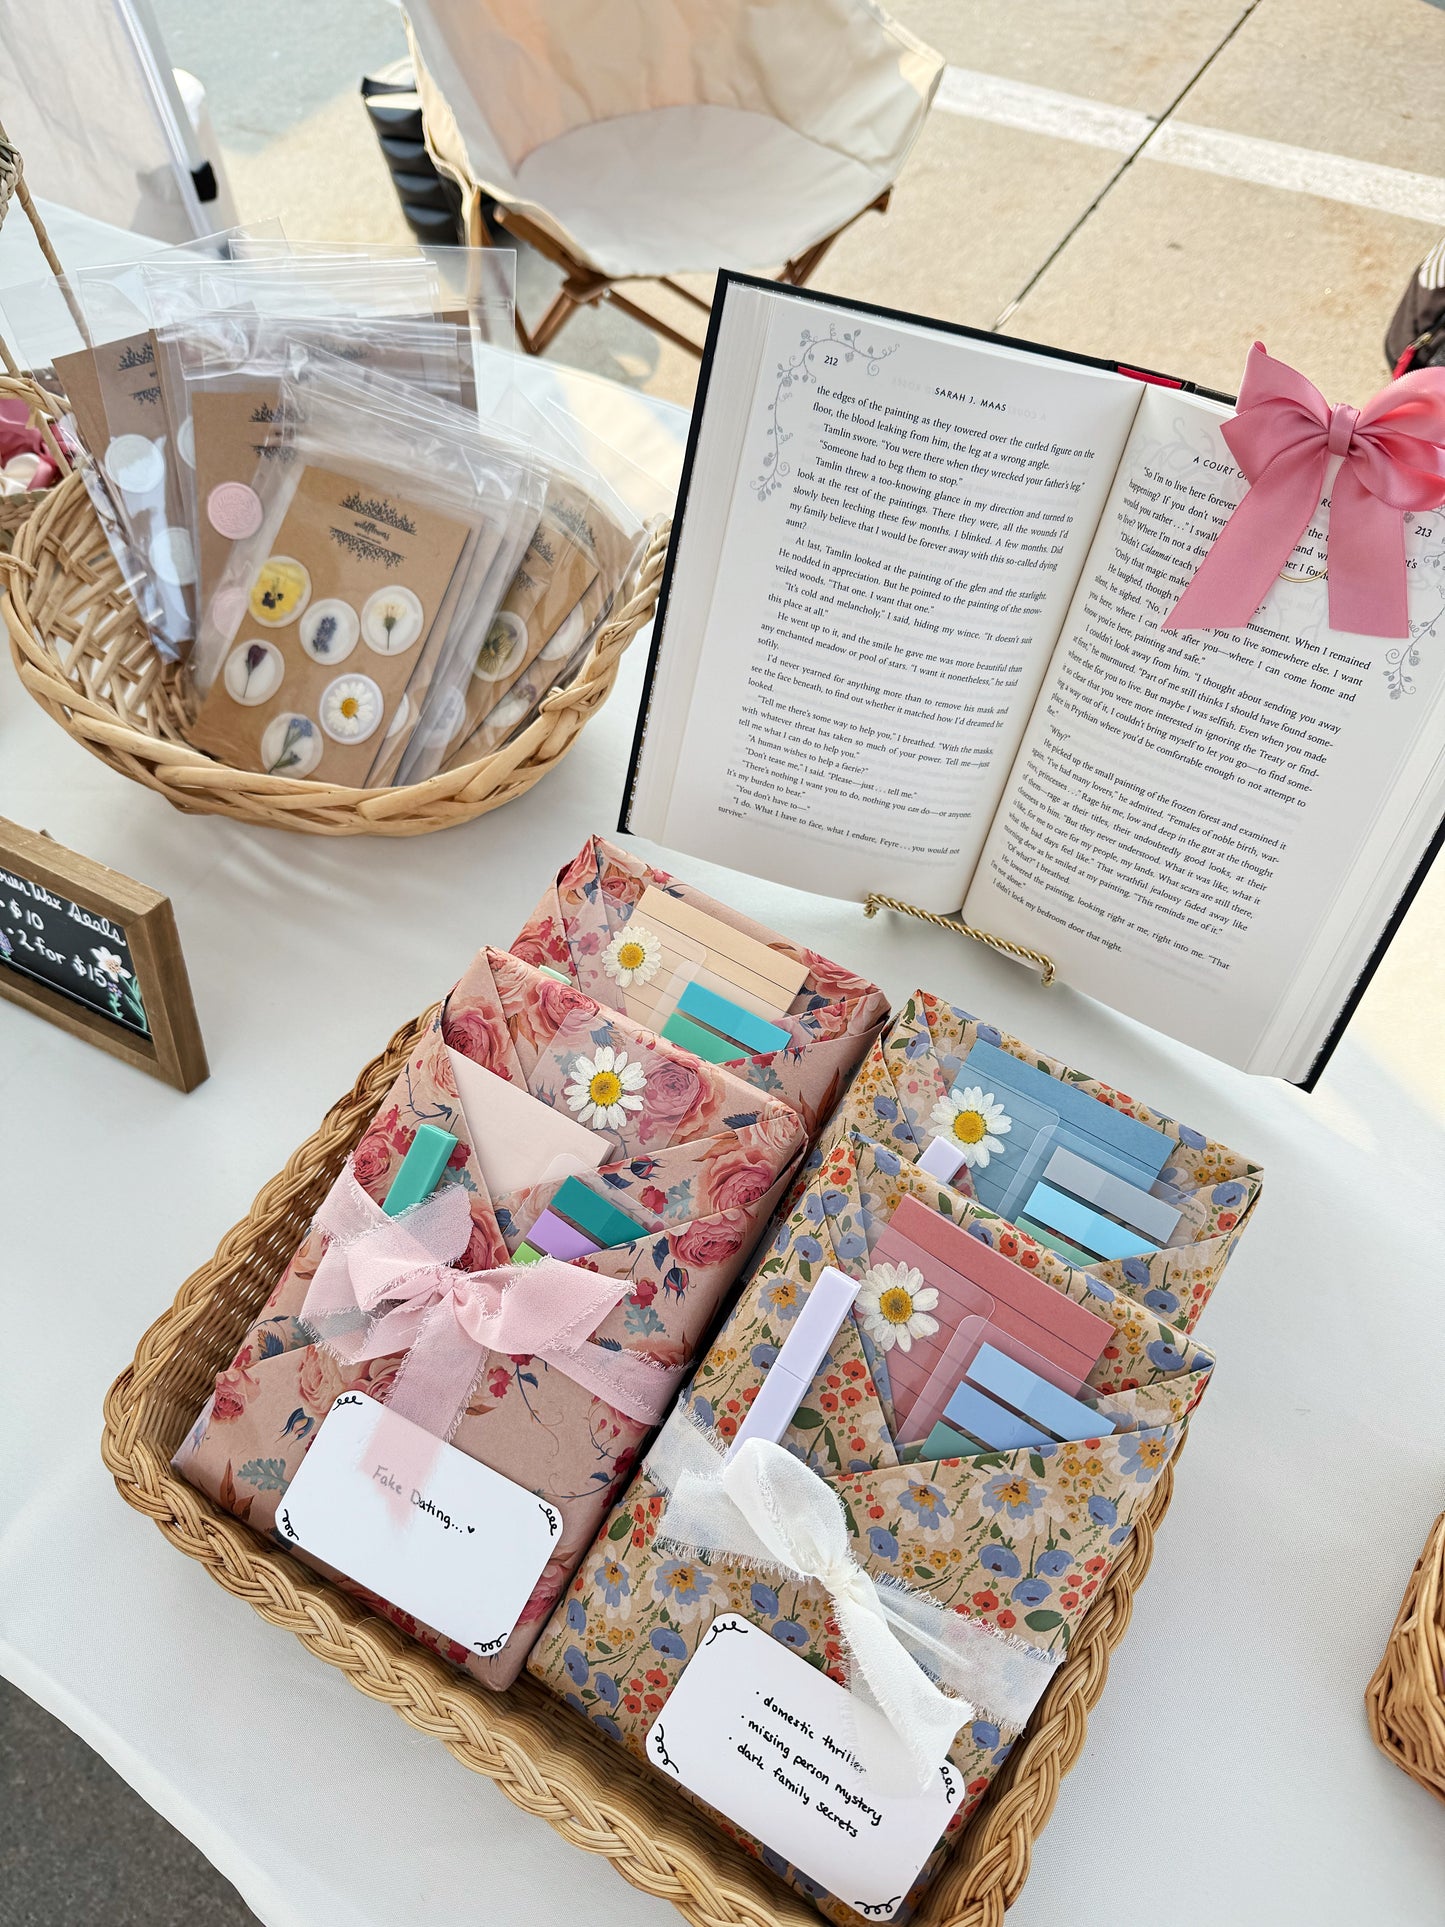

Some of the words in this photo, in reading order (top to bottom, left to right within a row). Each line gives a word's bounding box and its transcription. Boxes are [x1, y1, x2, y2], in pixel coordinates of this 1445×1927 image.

[823, 355, 838, 367] 212
[817, 385, 830, 396] the
[832, 391, 855, 404] edges
[858, 398, 869, 407] of
[869, 400, 882, 411] the
[884, 407, 919, 424] painting
[933, 418, 952, 433] they
[954, 425, 988, 439] towered
[989, 434, 1008, 443] over
[1009, 436, 1023, 447] the
[1024, 441, 1050, 452] curled
[1050, 444, 1072, 456] figure
[1084, 449, 1095, 459] the
[934, 387, 966, 402] SARAH
[969, 396, 976, 405] J.
[980, 398, 1007, 412] MAAS
[813, 402, 833, 417] floor,
[836, 409, 849, 420] the
[851, 413, 876, 428] blood
[877, 420, 908, 439] leaking
[909, 429, 929, 443] from
[931, 435, 950, 449] him,
[953, 441, 966, 452] the
[968, 444, 981, 458] leg
[1001, 454, 1027, 468] wrong
[1027, 460, 1050, 471] angle.
[824, 423, 851, 439] Tamlin
[852, 434, 878, 447] swore.
[902, 448, 922, 458] were
[923, 452, 944, 464] there
[946, 459, 969, 471] when
[971, 464, 989, 477] they
[991, 470, 1025, 482] wrecked
[1025, 477, 1043, 486] your
[816, 456, 842, 472] Tamlin
[845, 466, 869, 479] threw
[879, 477, 932, 499] too-knowing
[933, 491, 961, 504] glance
[963, 497, 972, 506] in
[974, 502, 987, 512] my
[989, 503, 1024, 517] direction
[1026, 511, 1041, 519] and
[1042, 513, 1066, 522] turned
[860, 451, 876, 464] had
[878, 459, 886, 467] to
[888, 459, 904, 474] beg
[906, 465, 926, 478] them
[1193, 456, 1200, 464] A
[1203, 459, 1234, 476] COURT
[1165, 479, 1173, 487] to
[1173, 480, 1187, 493] live
[1188, 486, 1206, 500] here
[1207, 493, 1237, 511] forever
[1307, 528, 1323, 540] the
[1415, 526, 1432, 538] 213
[795, 537, 805, 546] At
[807, 539, 822, 552] last,
[826, 545, 852, 560] Tamlin
[854, 553, 882, 568] looked
[893, 565, 906, 575] the
[908, 571, 942, 586] painting
[944, 578, 955, 586] of
[955, 580, 968, 589] the
[969, 583, 987, 593] glen
[988, 587, 1004, 595] and
[1005, 588, 1017, 598] the
[1018, 591, 1046, 602] starlight.
[777, 611, 789, 621] He
[791, 617, 809, 628] went
[810, 624, 820, 633] up
[841, 633, 857, 641] and
[858, 636, 870, 646] the
[872, 641, 892, 651] smile
[894, 645, 904, 654] he
[905, 650, 924, 659] gave
[925, 654, 937, 662] me
[939, 657, 954, 665] was
[955, 660, 975, 668] more
[976, 661, 1008, 672] beautiful
[1213, 629, 1230, 639] you
[1232, 635, 1241, 643] to
[1243, 637, 1259, 650] live
[1260, 646, 1309, 667] somewhere
[1311, 663, 1329, 675] else.
[1333, 669, 1339, 677] I
[1341, 674, 1363, 686] want
[1246, 622, 1290, 643] musement.
[1295, 637, 1320, 653] When
[1322, 647, 1328, 655] I
[1329, 651, 1372, 670] remained
[1044, 738, 1052, 749] He
[1051, 745, 1072, 760] picked
[1072, 757, 1082, 767] up
[1082, 761, 1094, 772] the
[1094, 768, 1114, 781] small
[1113, 777, 1146, 797] painting
[1147, 791, 1158, 799] of
[1157, 794, 1170, 804] the
[1171, 799, 1196, 815] frozen
[1197, 810, 1221, 824] forest
[1221, 821, 1238, 831] and
[1239, 828, 1279, 847] examined
[1279, 842, 1286, 850] it
[1011, 891, 1024, 904] lock
[1025, 901, 1036, 911] my
[1036, 906, 1067, 926] bedroom
[1068, 922, 1085, 934] door
[1086, 931, 1100, 942] that
[1101, 939, 1122, 952] night.
[34, 936, 66, 964] for
[72, 954, 108, 987] $15
[372, 1465, 402, 1494] Fake
[763, 1697, 814, 1739] domestic
[737, 1743, 764, 1770] dark
[773, 1767, 810, 1805] family
[816, 1802, 858, 1837] secrets
[748, 1720, 790, 1759] missing
[793, 1755, 829, 1784] person
[835, 1784, 882, 1826] mystery
